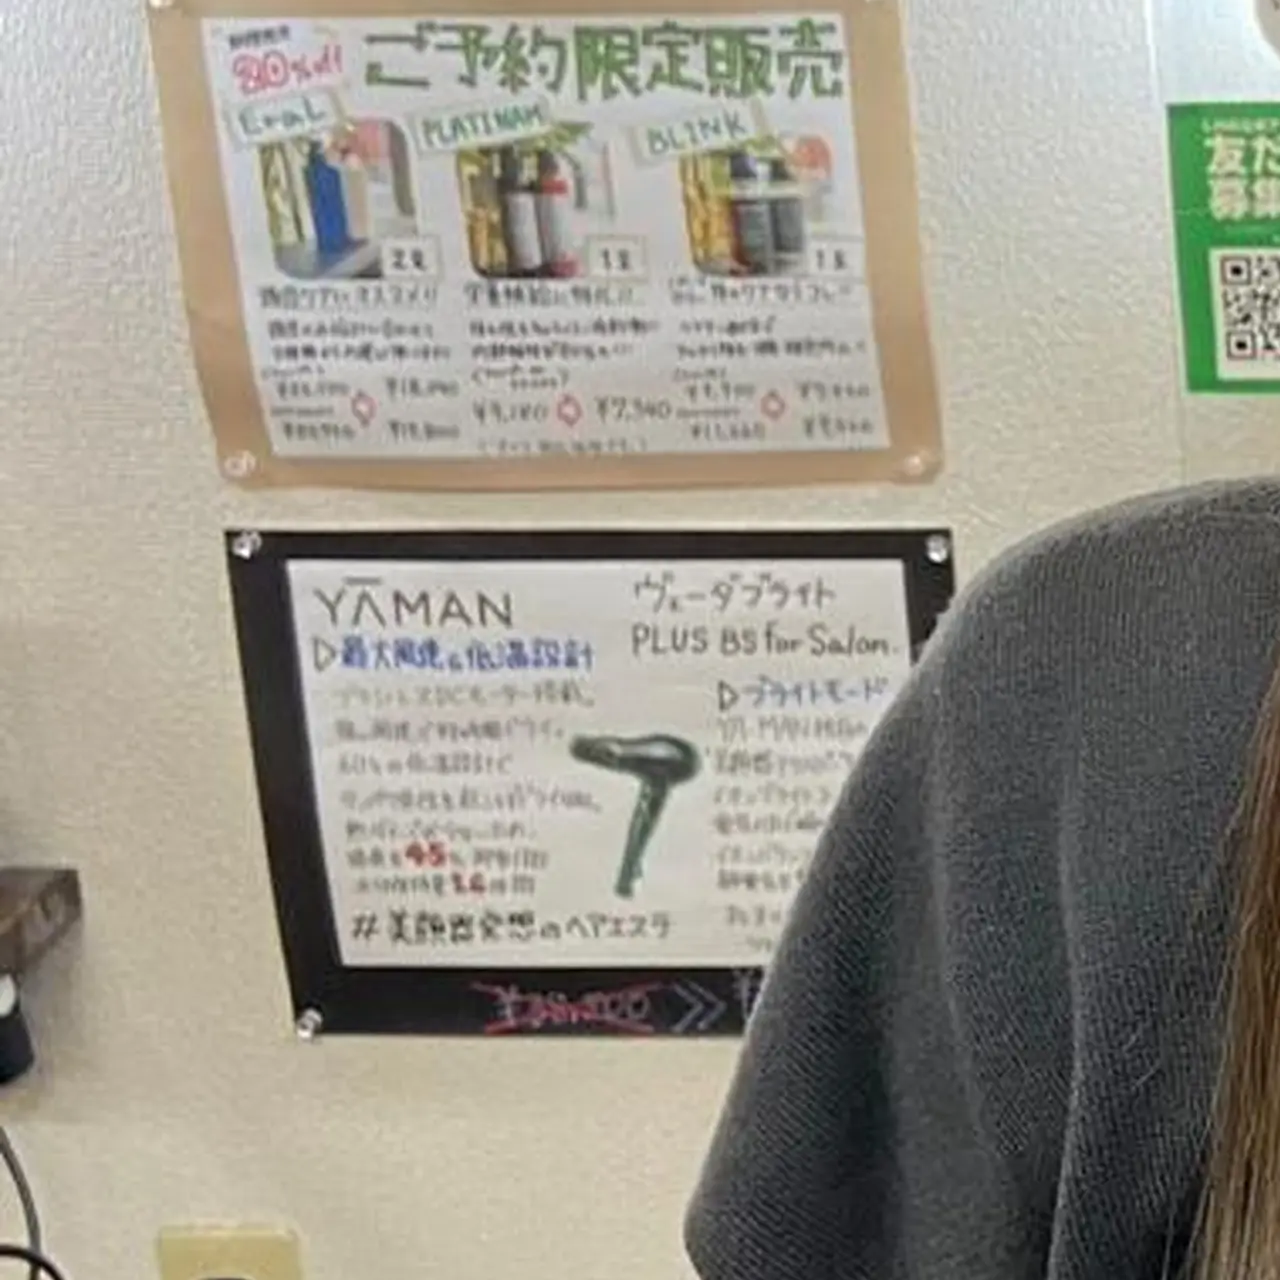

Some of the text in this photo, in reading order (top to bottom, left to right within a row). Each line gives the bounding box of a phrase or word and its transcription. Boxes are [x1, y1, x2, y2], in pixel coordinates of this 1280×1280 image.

[363, 19, 844, 102] ご予約限定販売
[648, 108, 748, 155] BLINK
[633, 572, 837, 614] ヴェーダブライト
[631, 623, 708, 658] PLUS
[720, 628, 757, 656] BS
[765, 622, 802, 656] for
[744, 674, 888, 708] ブライトモード
